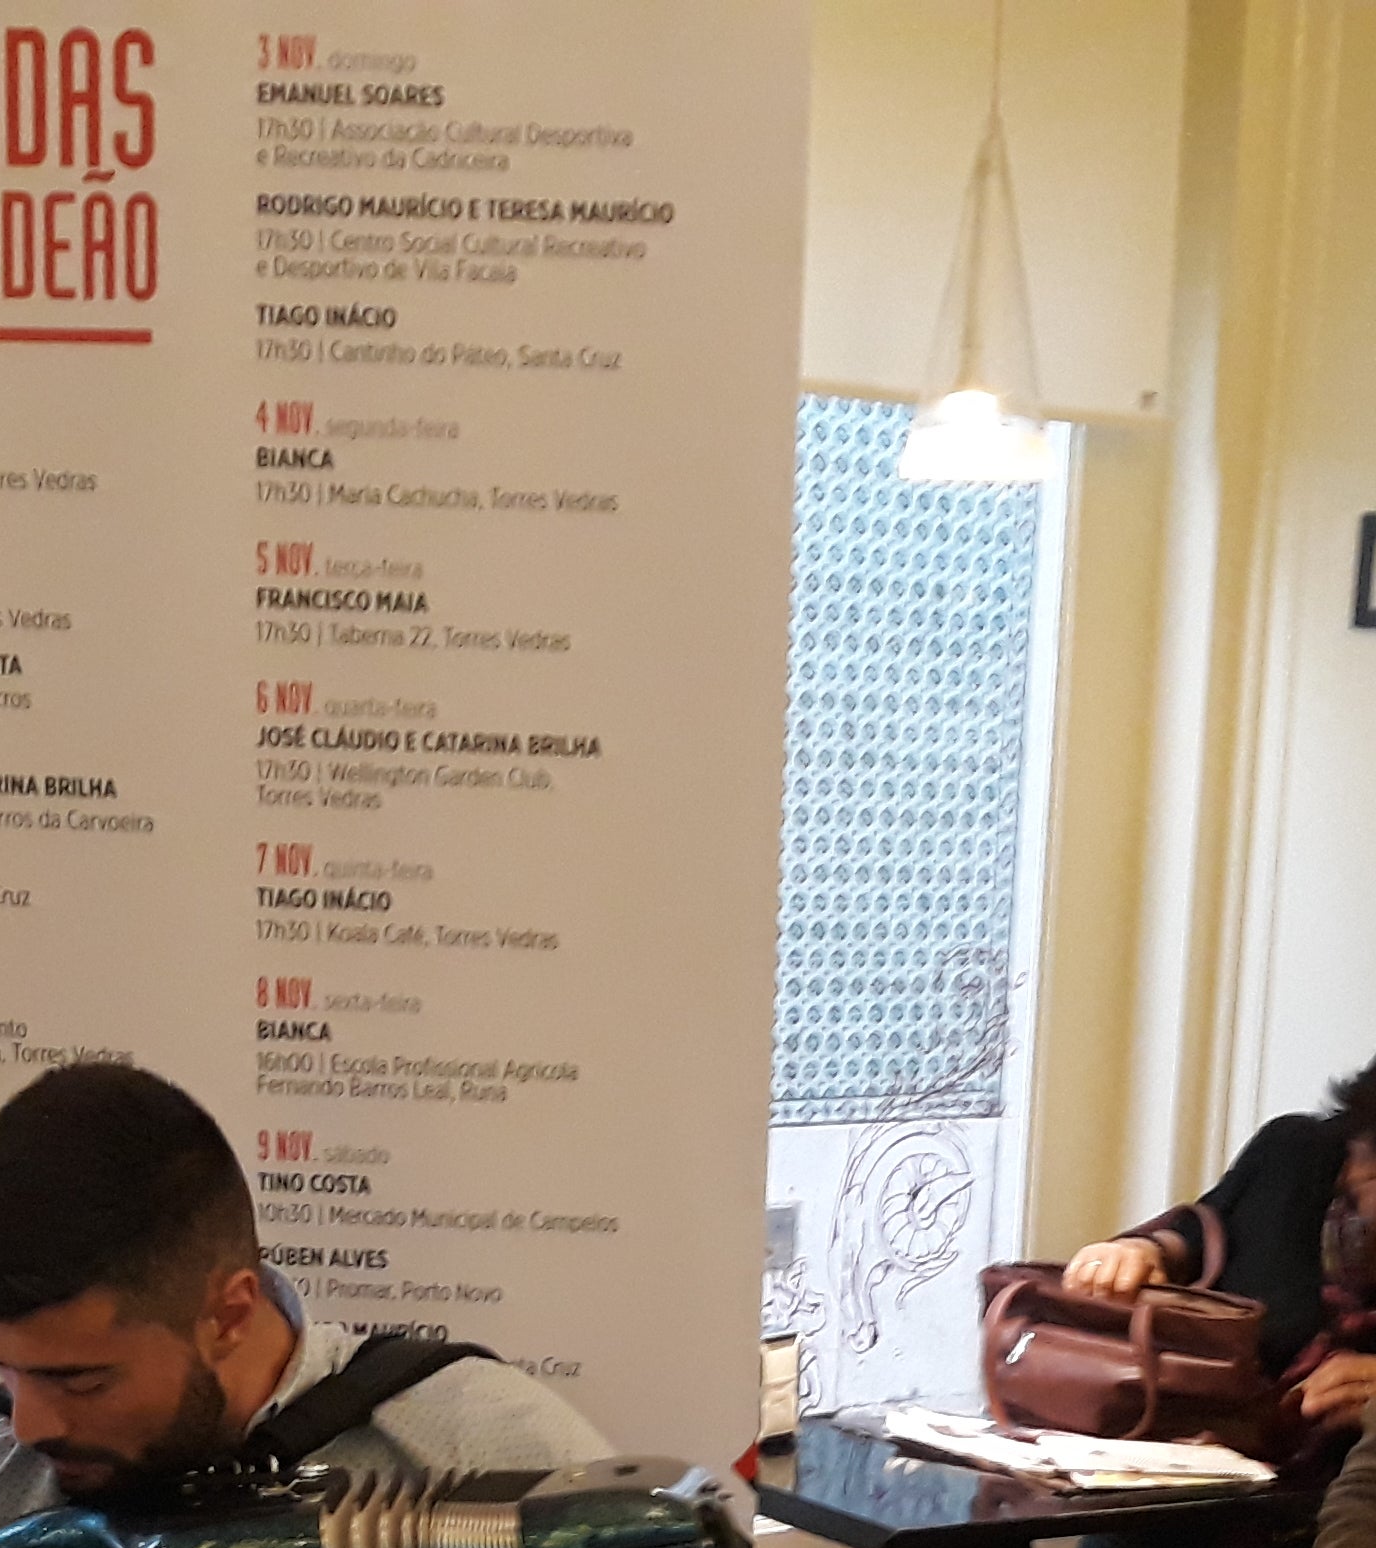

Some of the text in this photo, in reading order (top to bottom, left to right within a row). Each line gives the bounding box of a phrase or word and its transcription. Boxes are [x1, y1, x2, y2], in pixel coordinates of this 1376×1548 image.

[258, 34, 271, 69] 3
[328, 52, 416, 74] domingo
[257, 83, 445, 107] EMANUEL SOARES
[256, 193, 673, 224] RODRIGO MAURÍCIO E TERESA MAURÍCIO
[256, 304, 397, 328] TIAGO INÁCIO
[256, 401, 268, 432] 4
[256, 448, 334, 468] BIANCA
[33, 469, 97, 491] Vedras
[257, 541, 268, 575] 5
[257, 587, 428, 612] FRANCISCO MAIA
[9, 609, 71, 630] Vedras
[257, 621, 310, 642] 17h30
[330, 624, 403, 645] Taberna
[444, 627, 501, 648] Torres
[508, 628, 570, 651] Vedras
[257, 680, 268, 714] 6
[257, 725, 600, 757] JOSÉ CLÁUDIO E CATARINA BRILHA
[45, 778, 116, 797] BRILHA
[39, 811, 61, 828] da
[67, 811, 153, 833] Carvoeira
[257, 843, 268, 876] 7
[257, 887, 392, 911] TIAGO INÁCIO
[257, 976, 268, 1009] 8
[257, 1021, 332, 1041] BIANCA
[13, 1042, 67, 1064] Torres
[73, 1045, 134, 1066] Vedras
[257, 1129, 268, 1161] 9
[257, 1172, 371, 1194] TINO COSTA
[329, 1248, 388, 1269] ALVES
